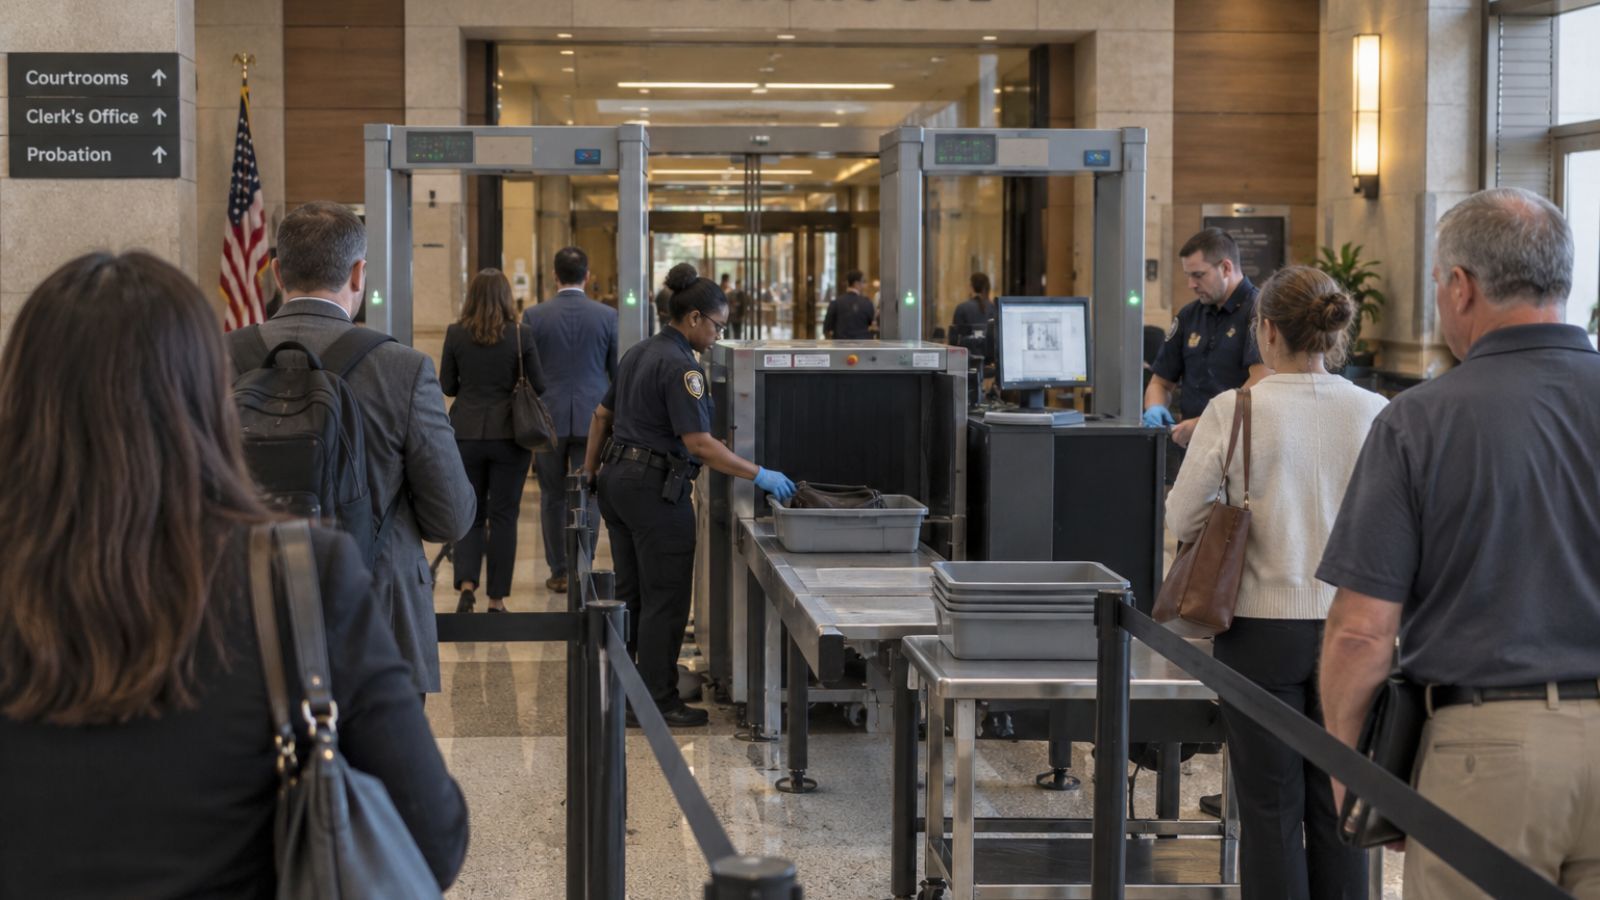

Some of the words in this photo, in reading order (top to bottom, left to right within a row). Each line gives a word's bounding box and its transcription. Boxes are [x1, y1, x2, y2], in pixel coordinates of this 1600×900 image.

[25, 69, 129, 86] Courtrooms
[26, 108, 84, 124] Clerk's
[88, 108, 139, 124] Office
[27, 146, 112, 162] Probation
